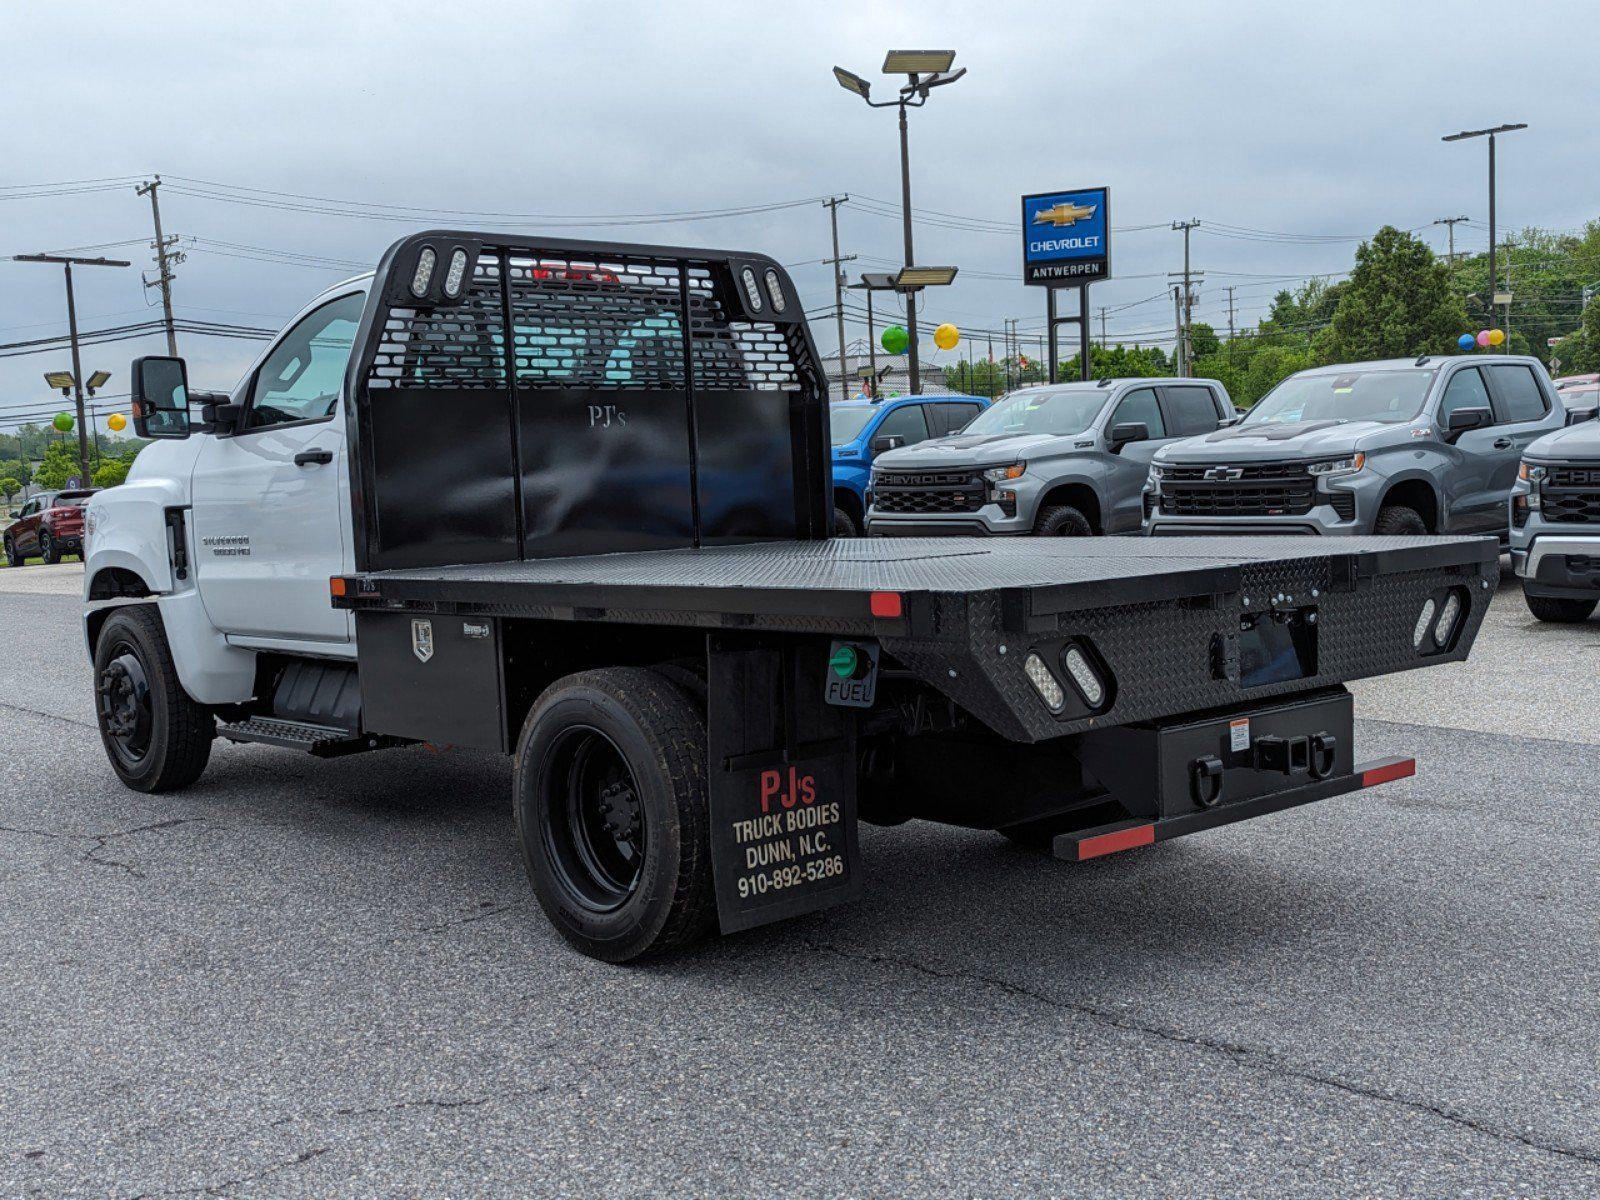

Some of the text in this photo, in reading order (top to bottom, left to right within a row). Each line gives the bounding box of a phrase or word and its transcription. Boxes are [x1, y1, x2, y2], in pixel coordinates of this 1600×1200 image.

[1030, 236, 1099, 252] CHEVROLET
[1032, 263, 1099, 278] ANTWERPEN
[588, 404, 626, 428] PJ's
[876, 474, 971, 484] CHEVROLET
[829, 682, 871, 702] FUEL
[733, 802, 840, 844] TRUCK BODIES
[746, 831, 831, 869] DUNN, N.C.
[738, 855, 844, 898] 910-892-5286
